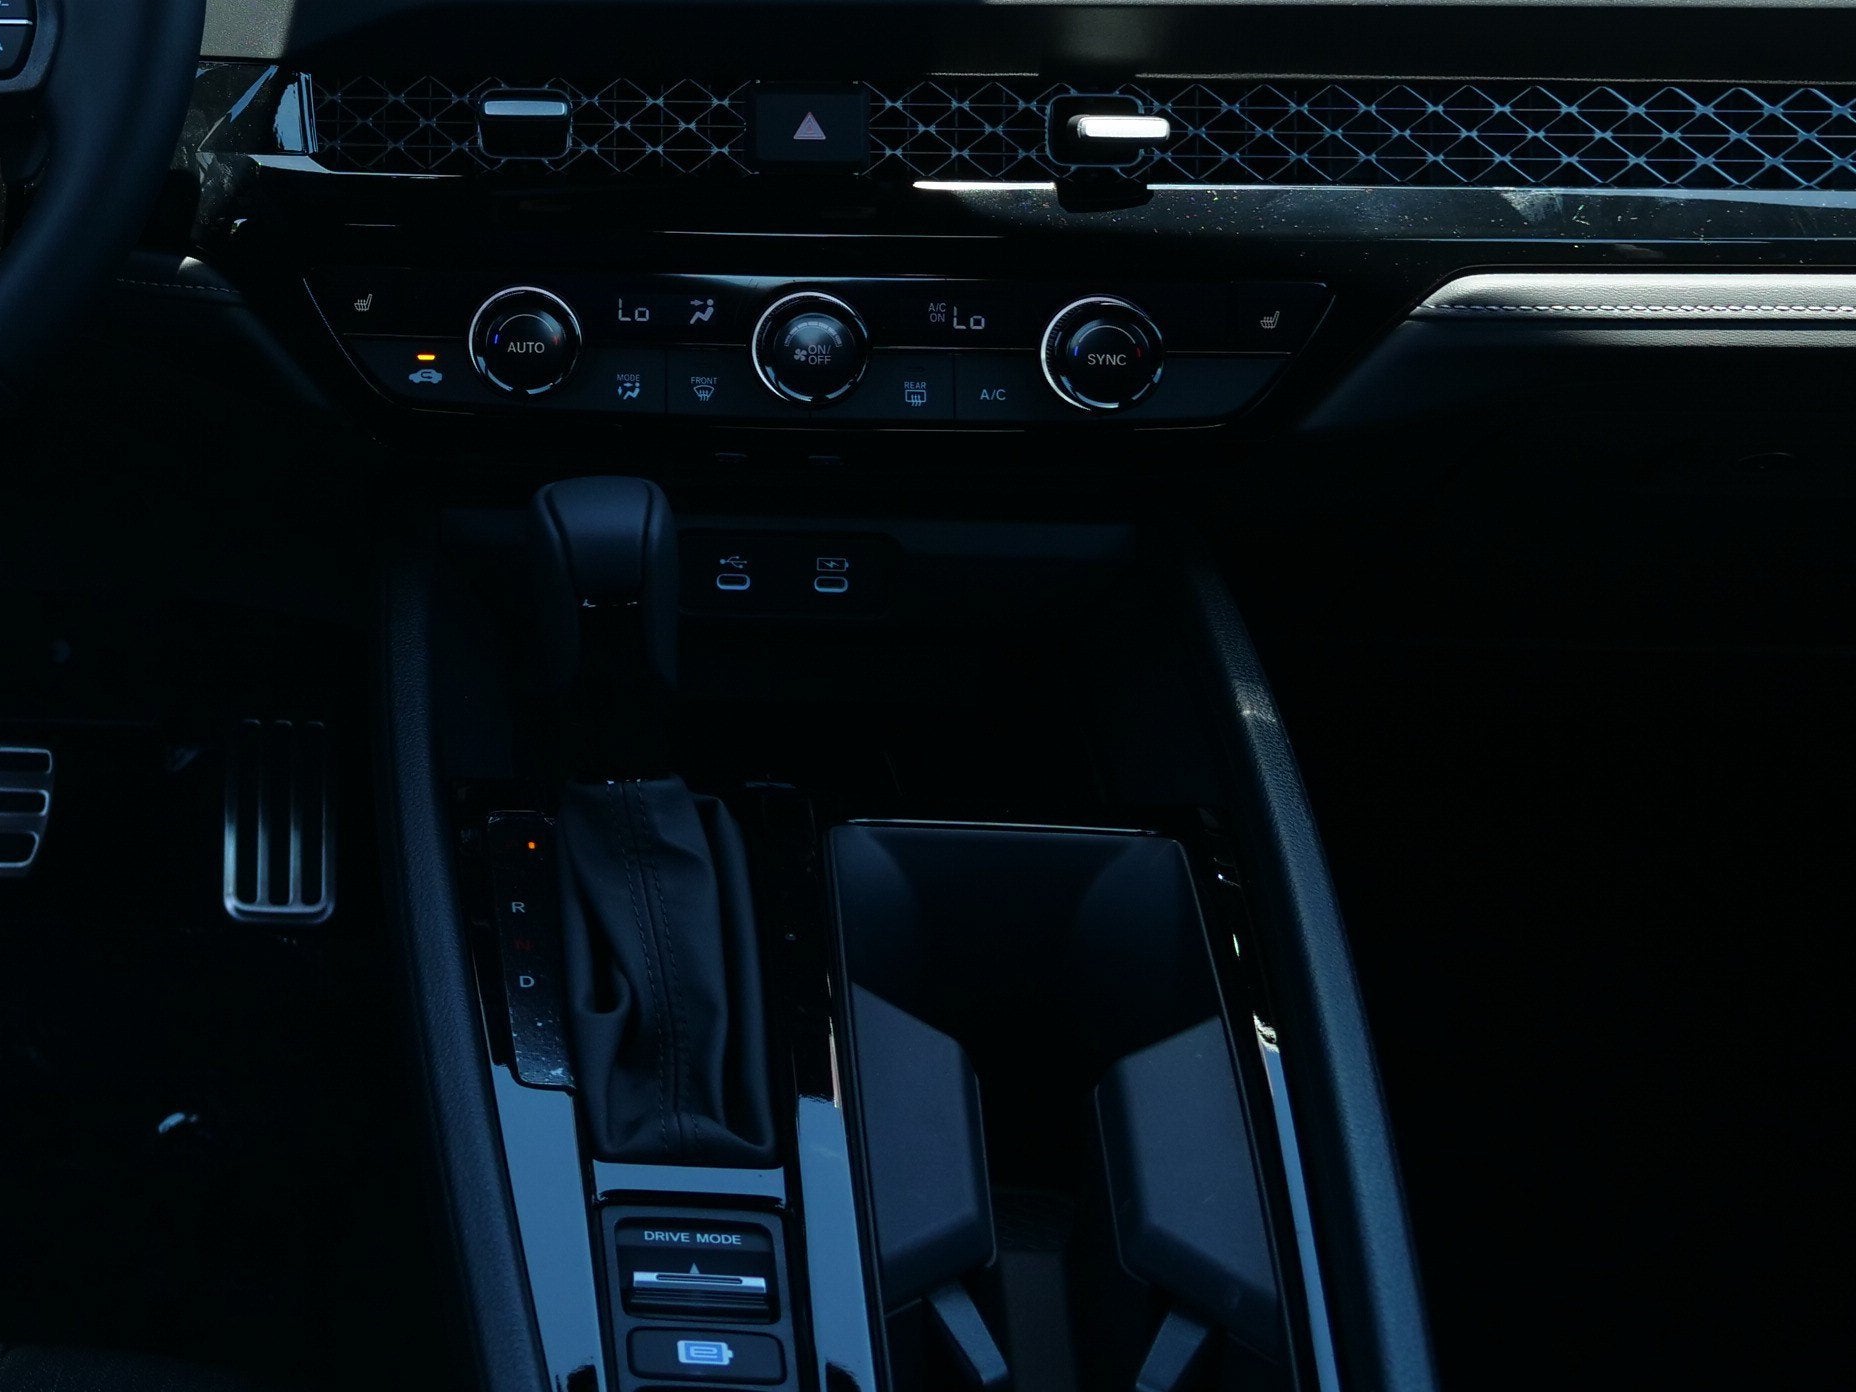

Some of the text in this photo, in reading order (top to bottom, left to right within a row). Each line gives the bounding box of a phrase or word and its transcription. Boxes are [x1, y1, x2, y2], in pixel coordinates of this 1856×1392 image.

[928, 302, 947, 313] A/C
[929, 313, 945, 323] ON
[507, 341, 545, 354] AUTO
[808, 355, 831, 365] OFF
[1087, 353, 1127, 366] SYNC
[616, 374, 640, 382] MODE
[690, 377, 718, 385] FRONT
[904, 381, 927, 390] REAR
[980, 389, 1006, 401] A/C
[512, 902, 526, 913] R
[519, 976, 535, 988] D
[644, 1231, 742, 1245] DRIVE MODE
